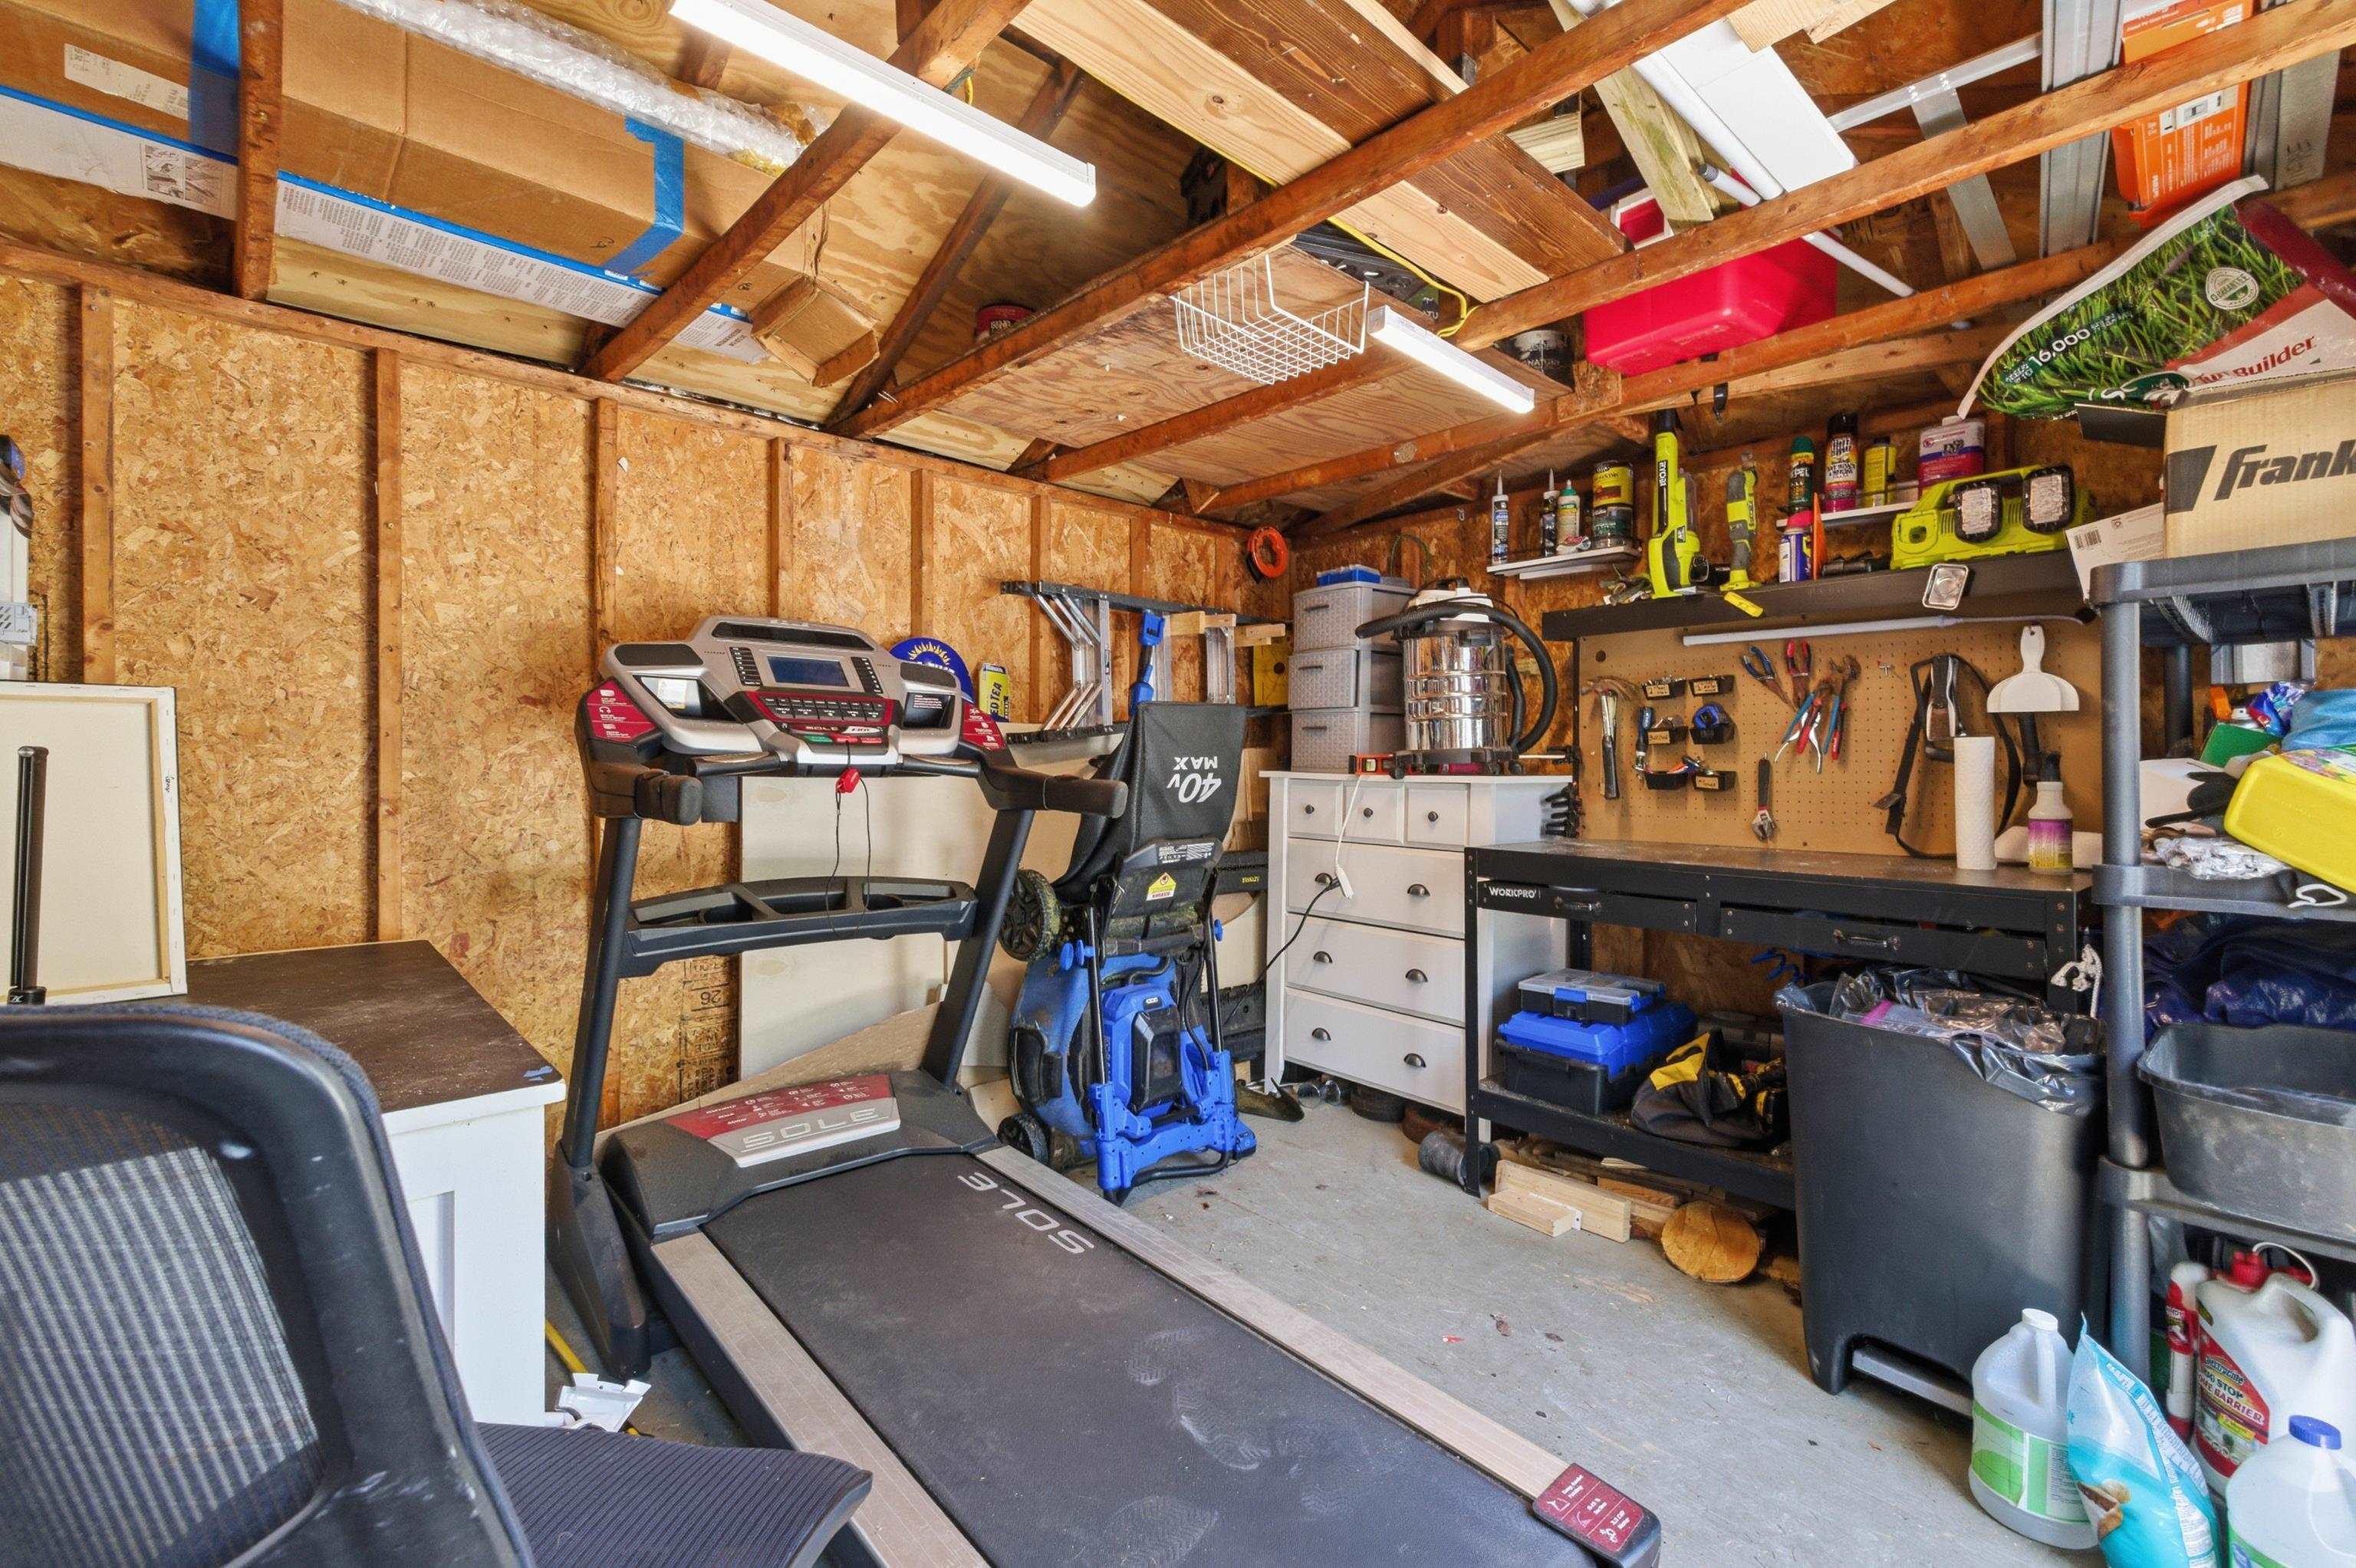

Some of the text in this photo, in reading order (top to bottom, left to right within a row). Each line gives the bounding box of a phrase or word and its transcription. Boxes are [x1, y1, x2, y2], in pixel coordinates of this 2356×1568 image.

[2029, 328, 2091, 367] 16,000
[2233, 336, 2315, 377] Builder
[1173, 756, 1218, 770] MAX
[1489, 886, 1535, 899] WORKPRO
[700, 989, 721, 1005] 26
[742, 1107, 880, 1149] SOLE
[958, 1172, 1094, 1254] SOLE
[2213, 1389, 2265, 1425] BARRIER
[2216, 1379, 2244, 1399] STOP
